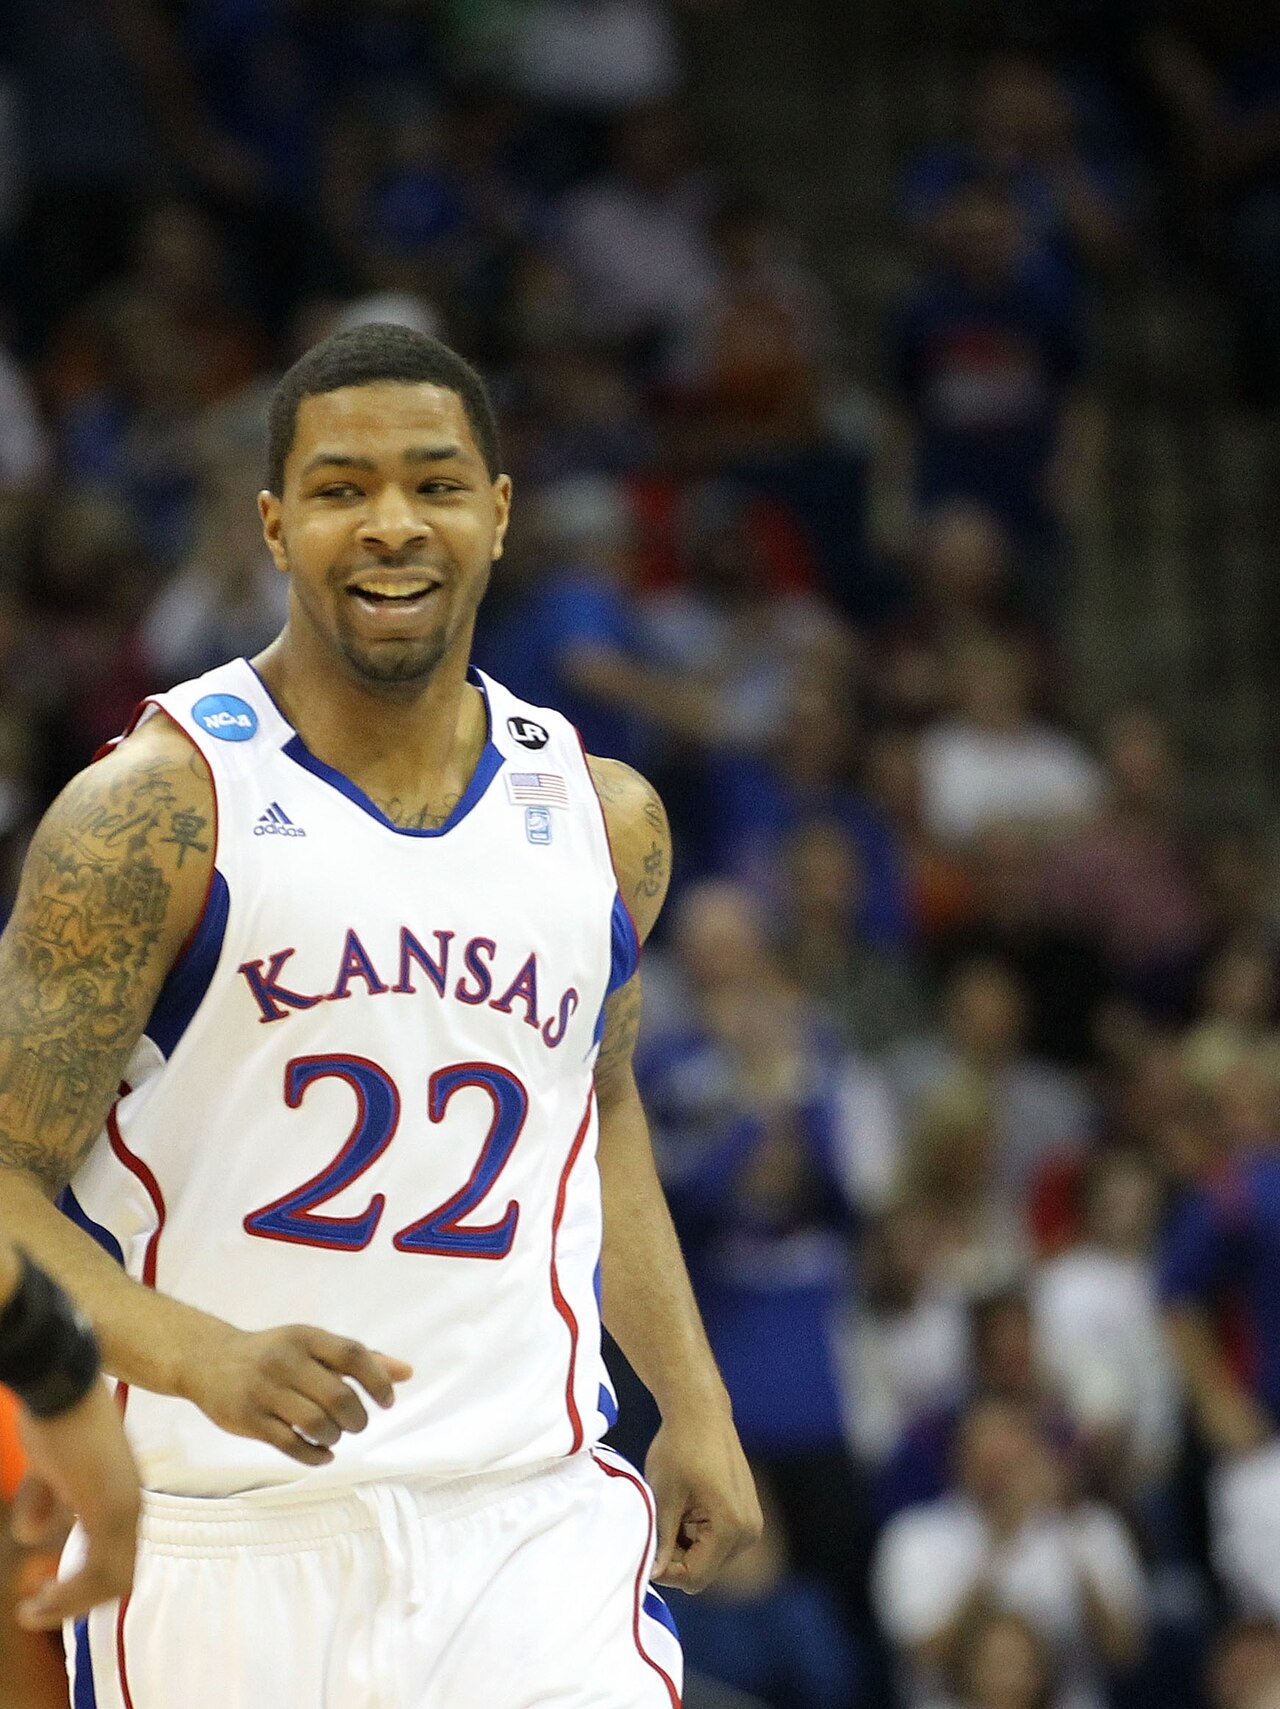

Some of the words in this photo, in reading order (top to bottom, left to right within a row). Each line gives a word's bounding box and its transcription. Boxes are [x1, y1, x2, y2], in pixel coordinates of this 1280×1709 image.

[202, 711, 253, 729] NCAA
[253, 823, 306, 838] adidas
[238, 926, 580, 1048] KANSAS
[243, 1053, 529, 1260] 22
